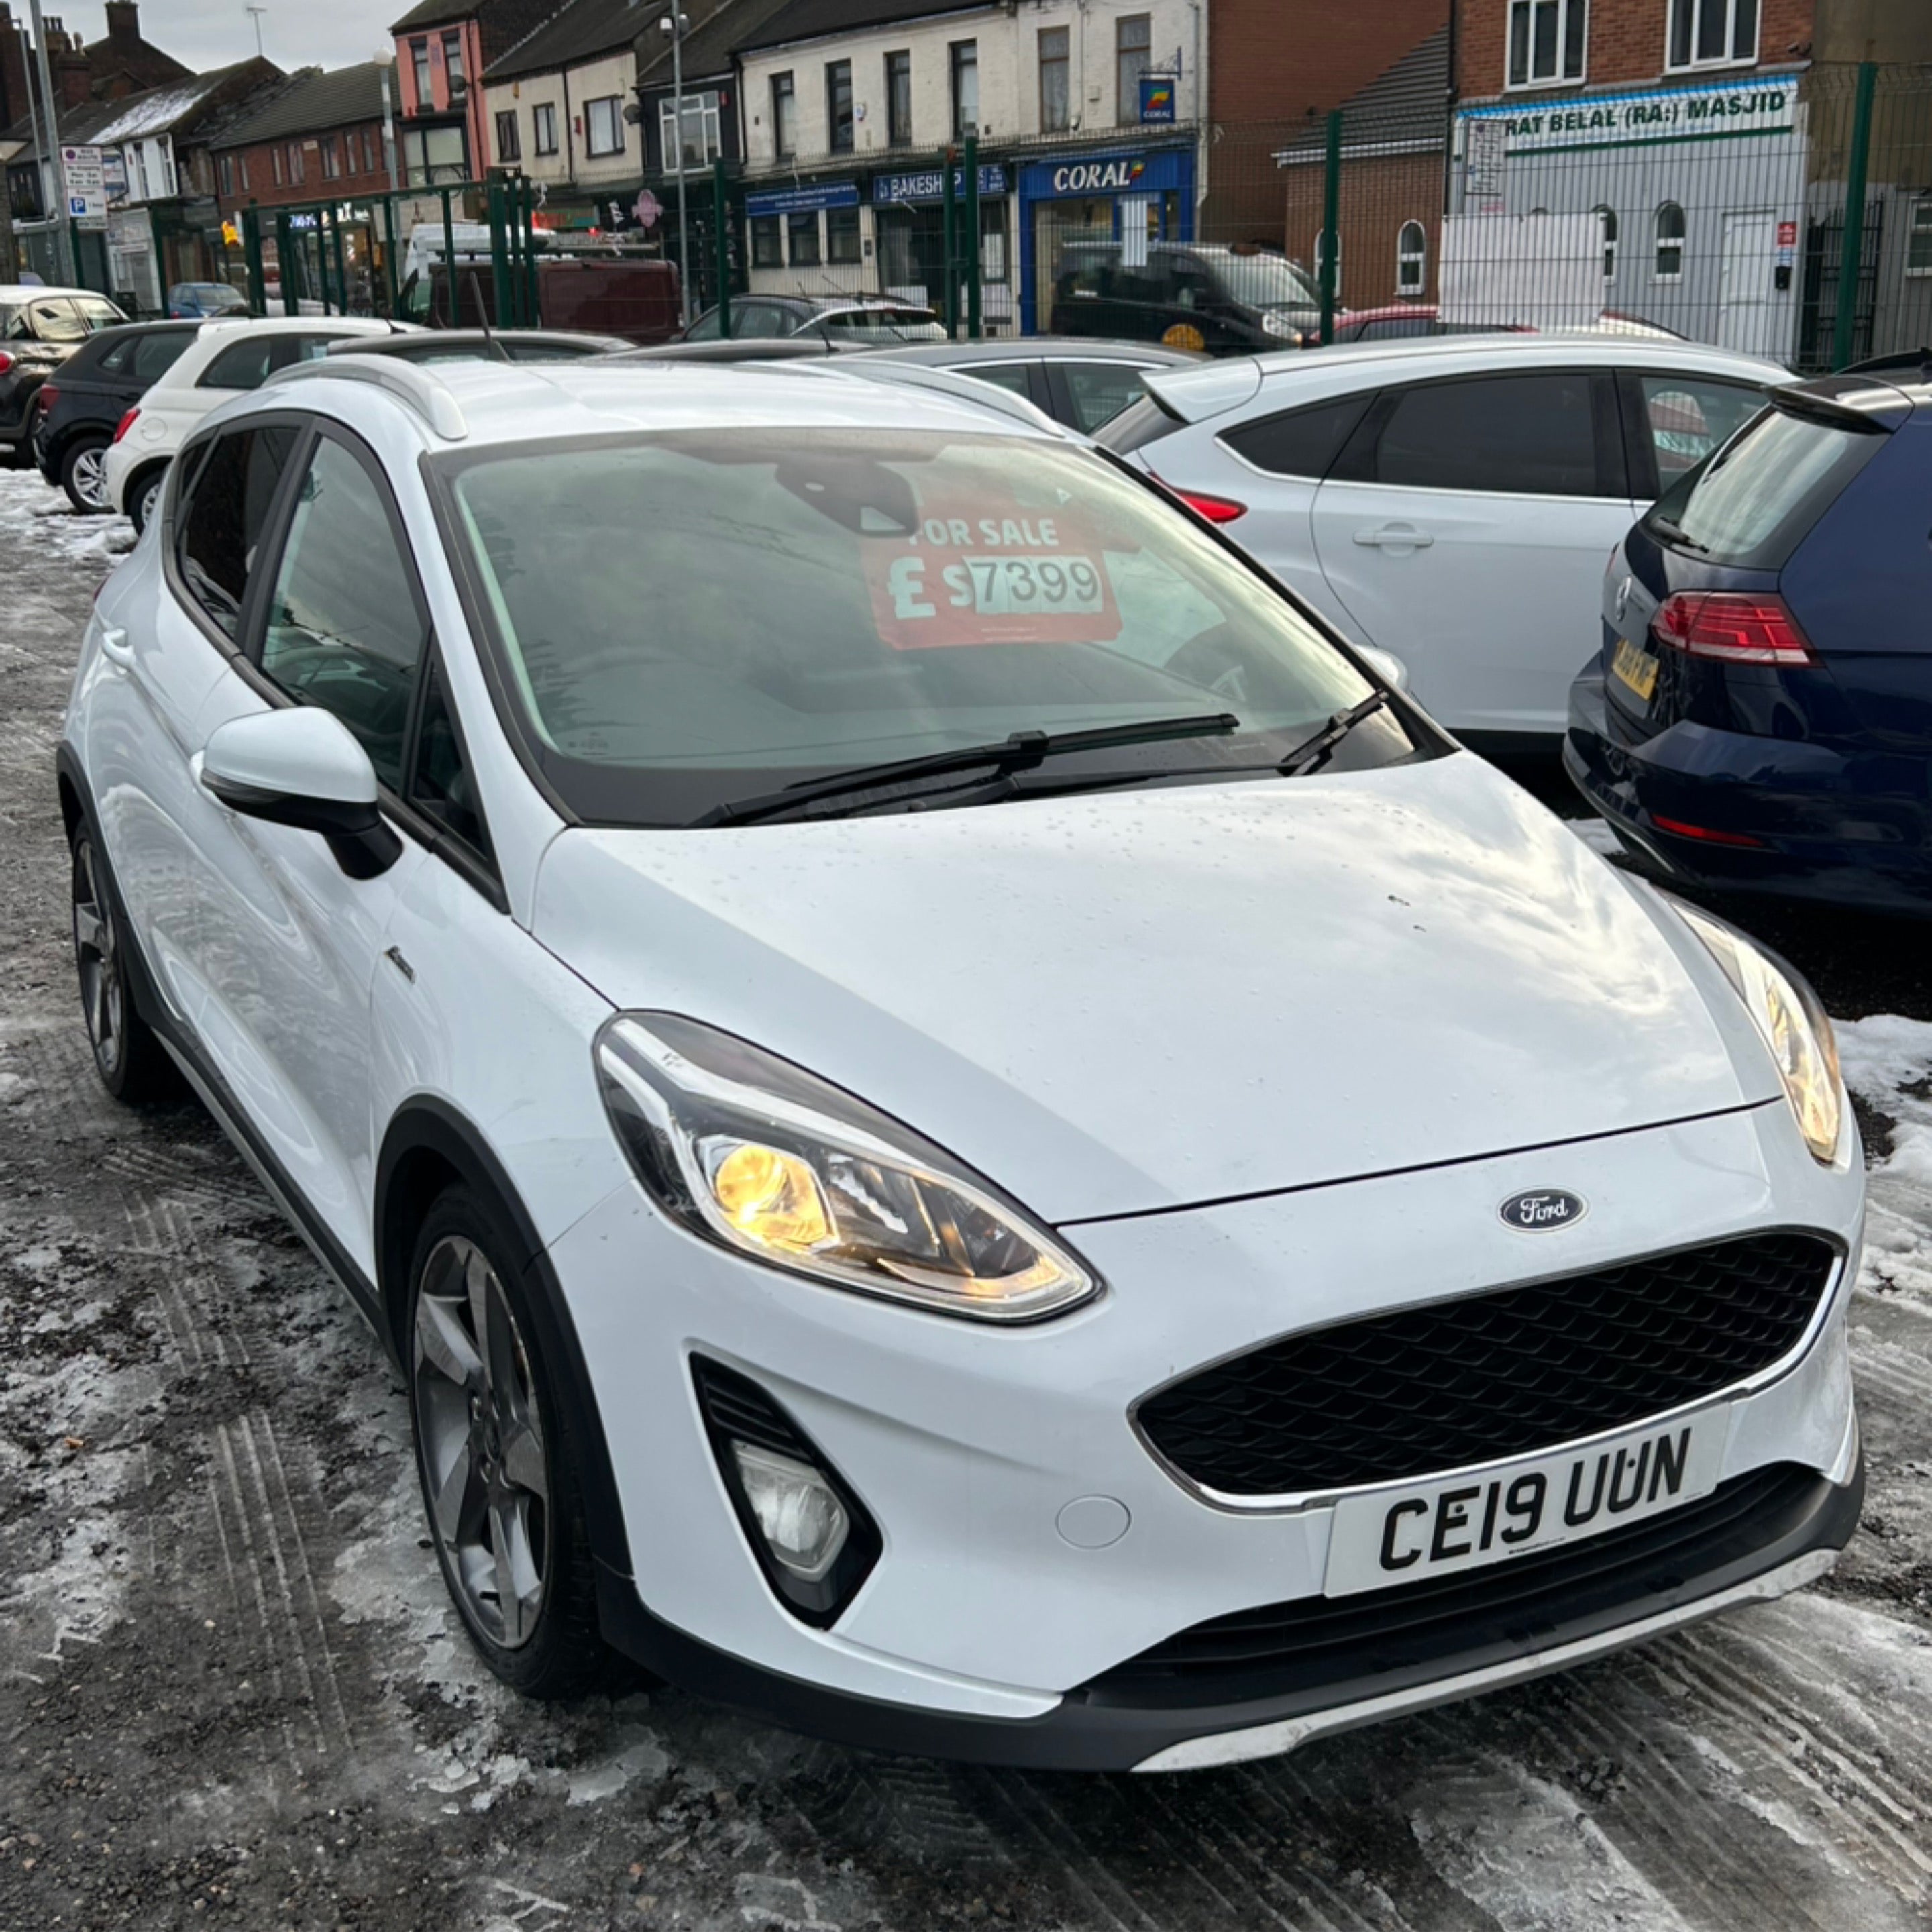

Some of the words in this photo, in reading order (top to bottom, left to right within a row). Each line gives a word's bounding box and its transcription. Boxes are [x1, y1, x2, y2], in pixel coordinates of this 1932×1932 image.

[1550, 109, 1616, 133] BELAL
[1688, 91, 1785, 119] MASJID
[890, 172, 961, 197] BAKESHP
[1054, 162, 1130, 191] CORAL
[979, 519, 1059, 546] SALE
[888, 556, 936, 619] £
[971, 561, 1099, 602] 7399
[1519, 1195, 1568, 1224] Ford
[1380, 1472, 1547, 1571] CE19
[1564, 1426, 1691, 1527] UUN
